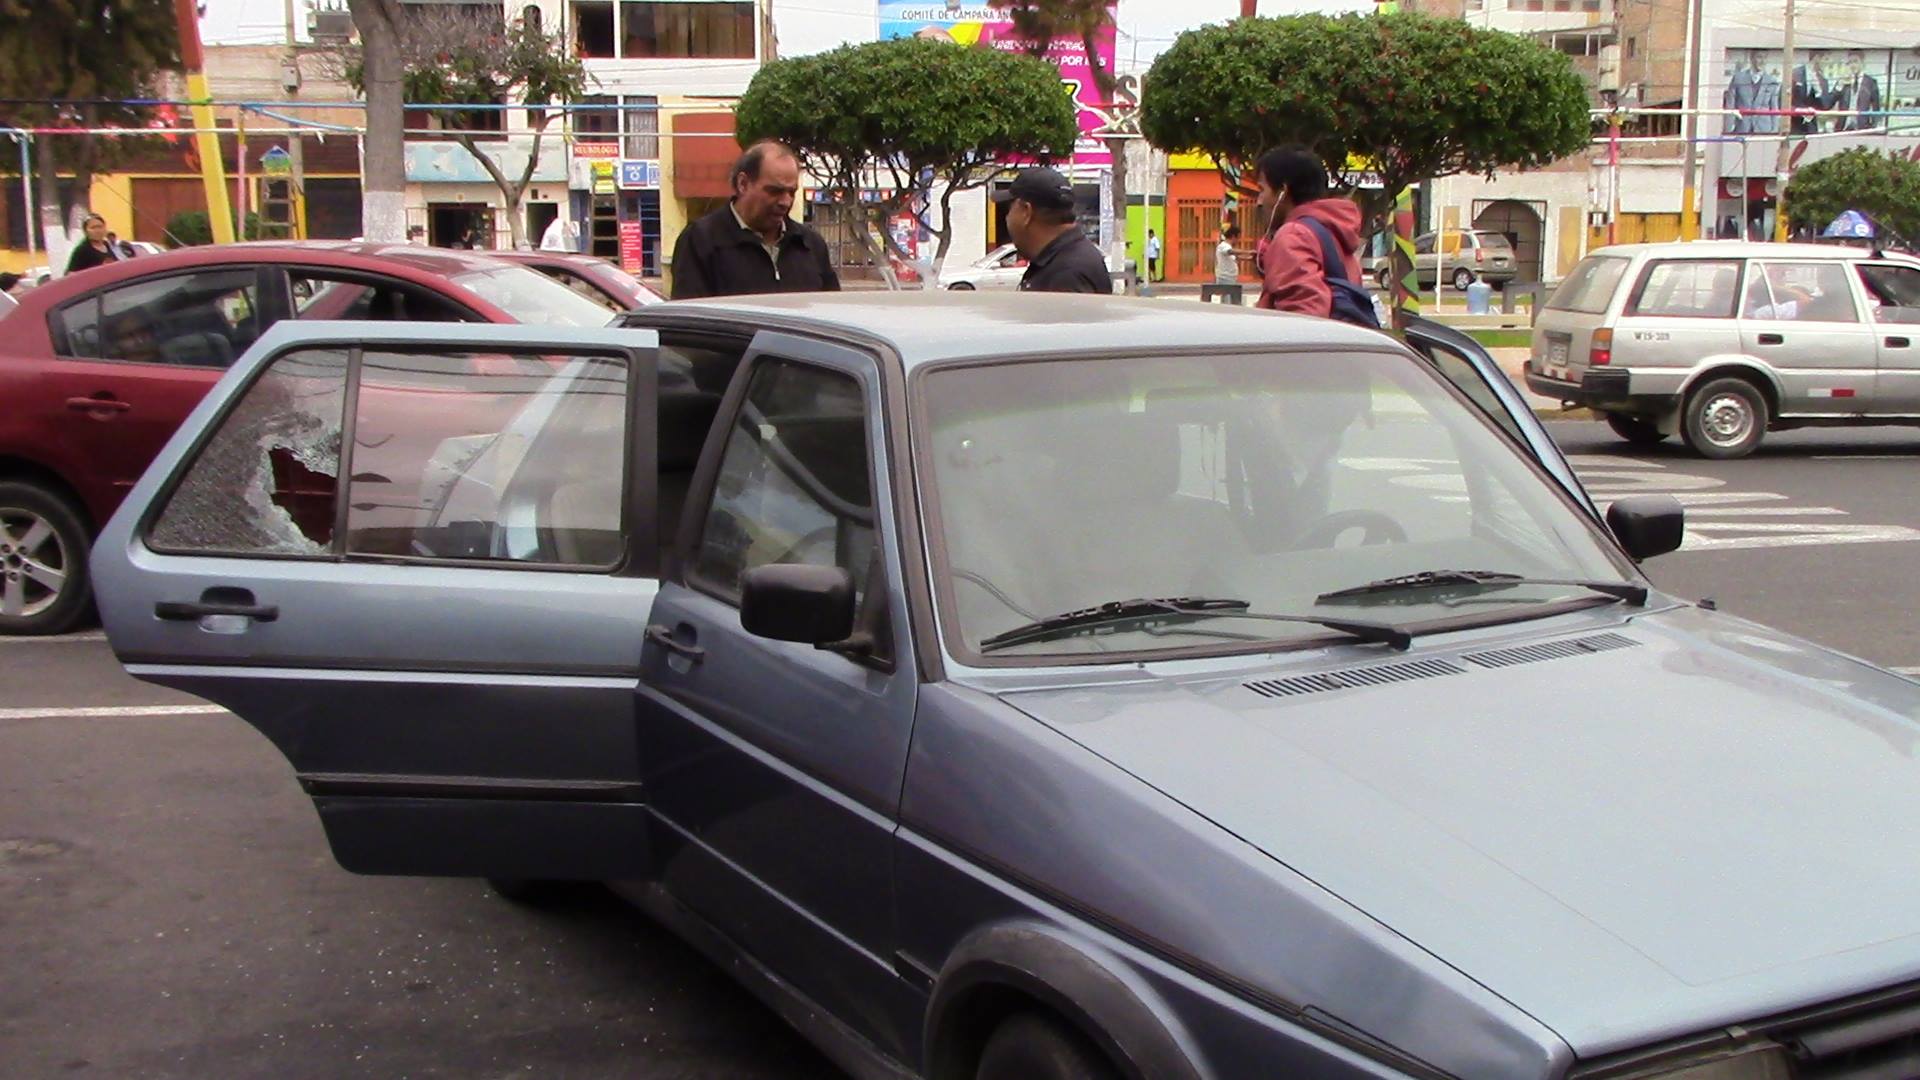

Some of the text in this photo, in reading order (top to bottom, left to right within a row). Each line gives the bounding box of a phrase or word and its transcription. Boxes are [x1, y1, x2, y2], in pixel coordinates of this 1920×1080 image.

[902, 8, 934, 20] COMITÉ
[938, 10, 949, 20] DE
[953, 9, 995, 20] CAMPAÑA
[1060, 56, 1082, 66] POR
